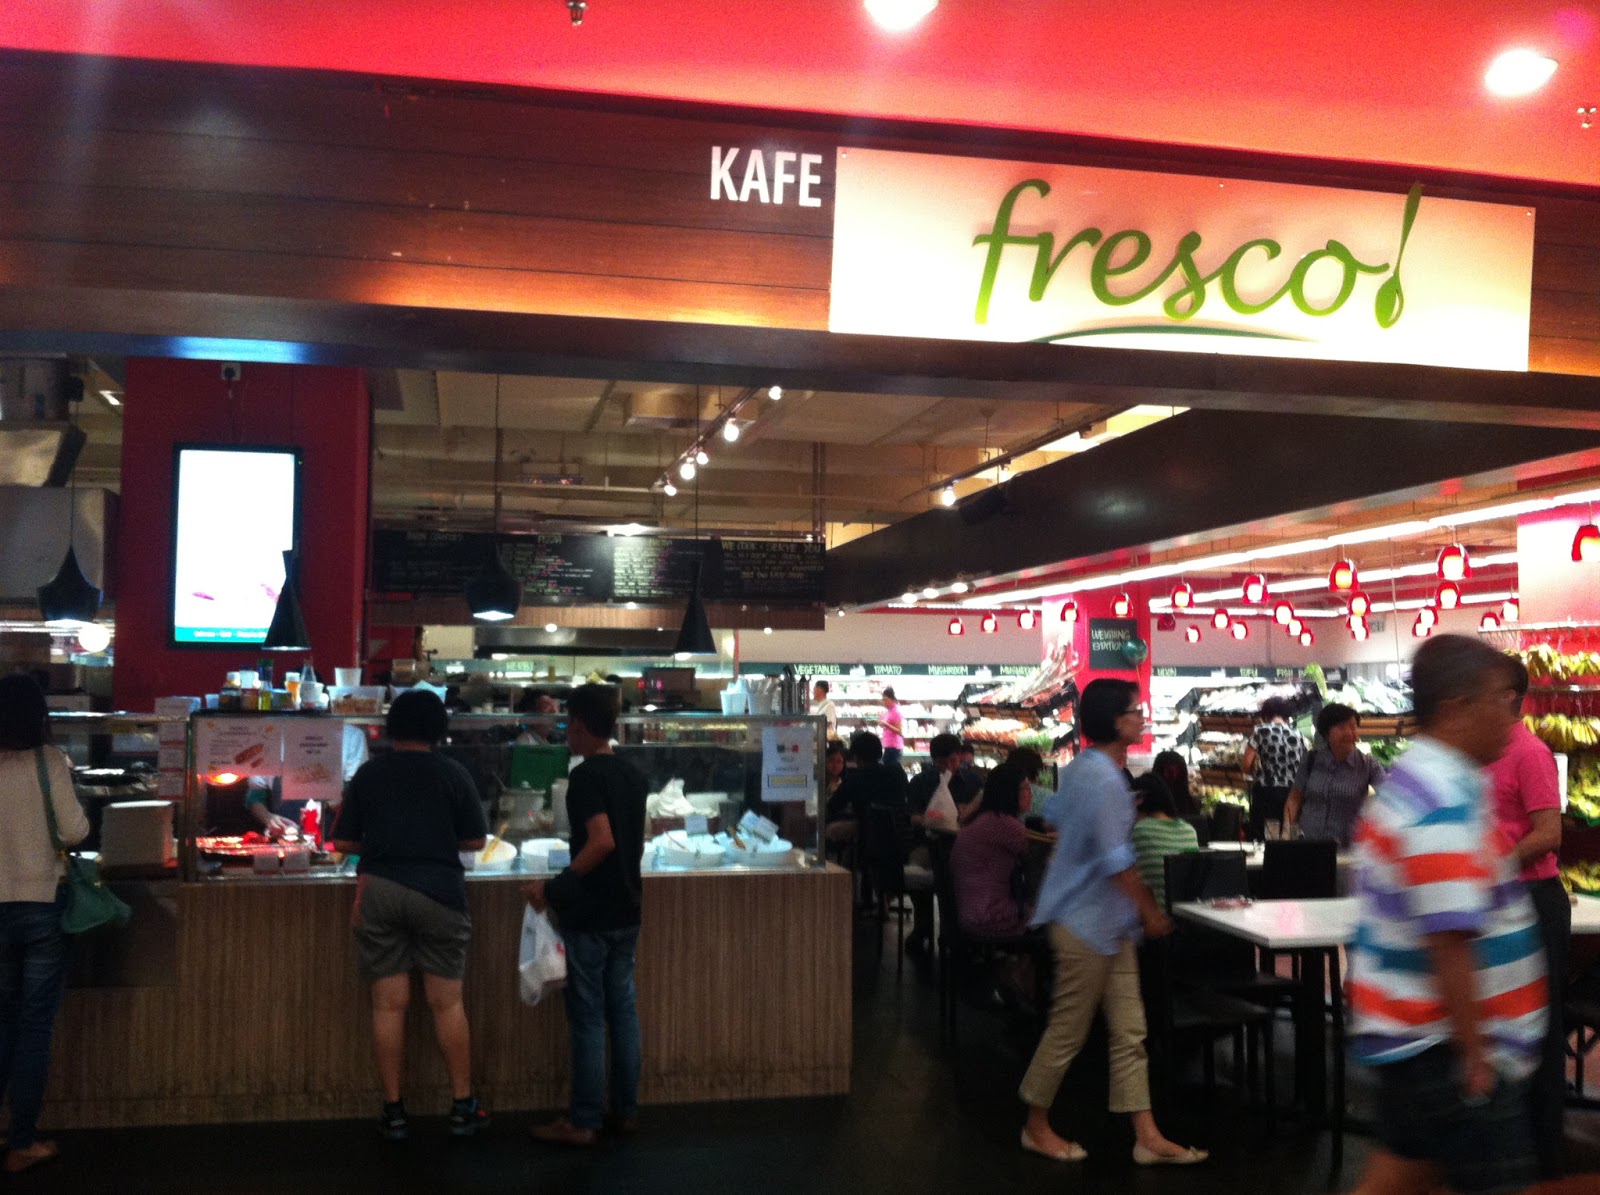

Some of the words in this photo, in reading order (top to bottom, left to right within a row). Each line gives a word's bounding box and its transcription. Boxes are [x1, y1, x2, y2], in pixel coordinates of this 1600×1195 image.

[709, 145, 823, 209] KAFE
[1091, 629, 1130, 640] WEIGHING
[794, 664, 840, 676] VEGETABLES
[873, 665, 902, 676] TOMATO
[927, 665, 968, 676] MUSHROOM
